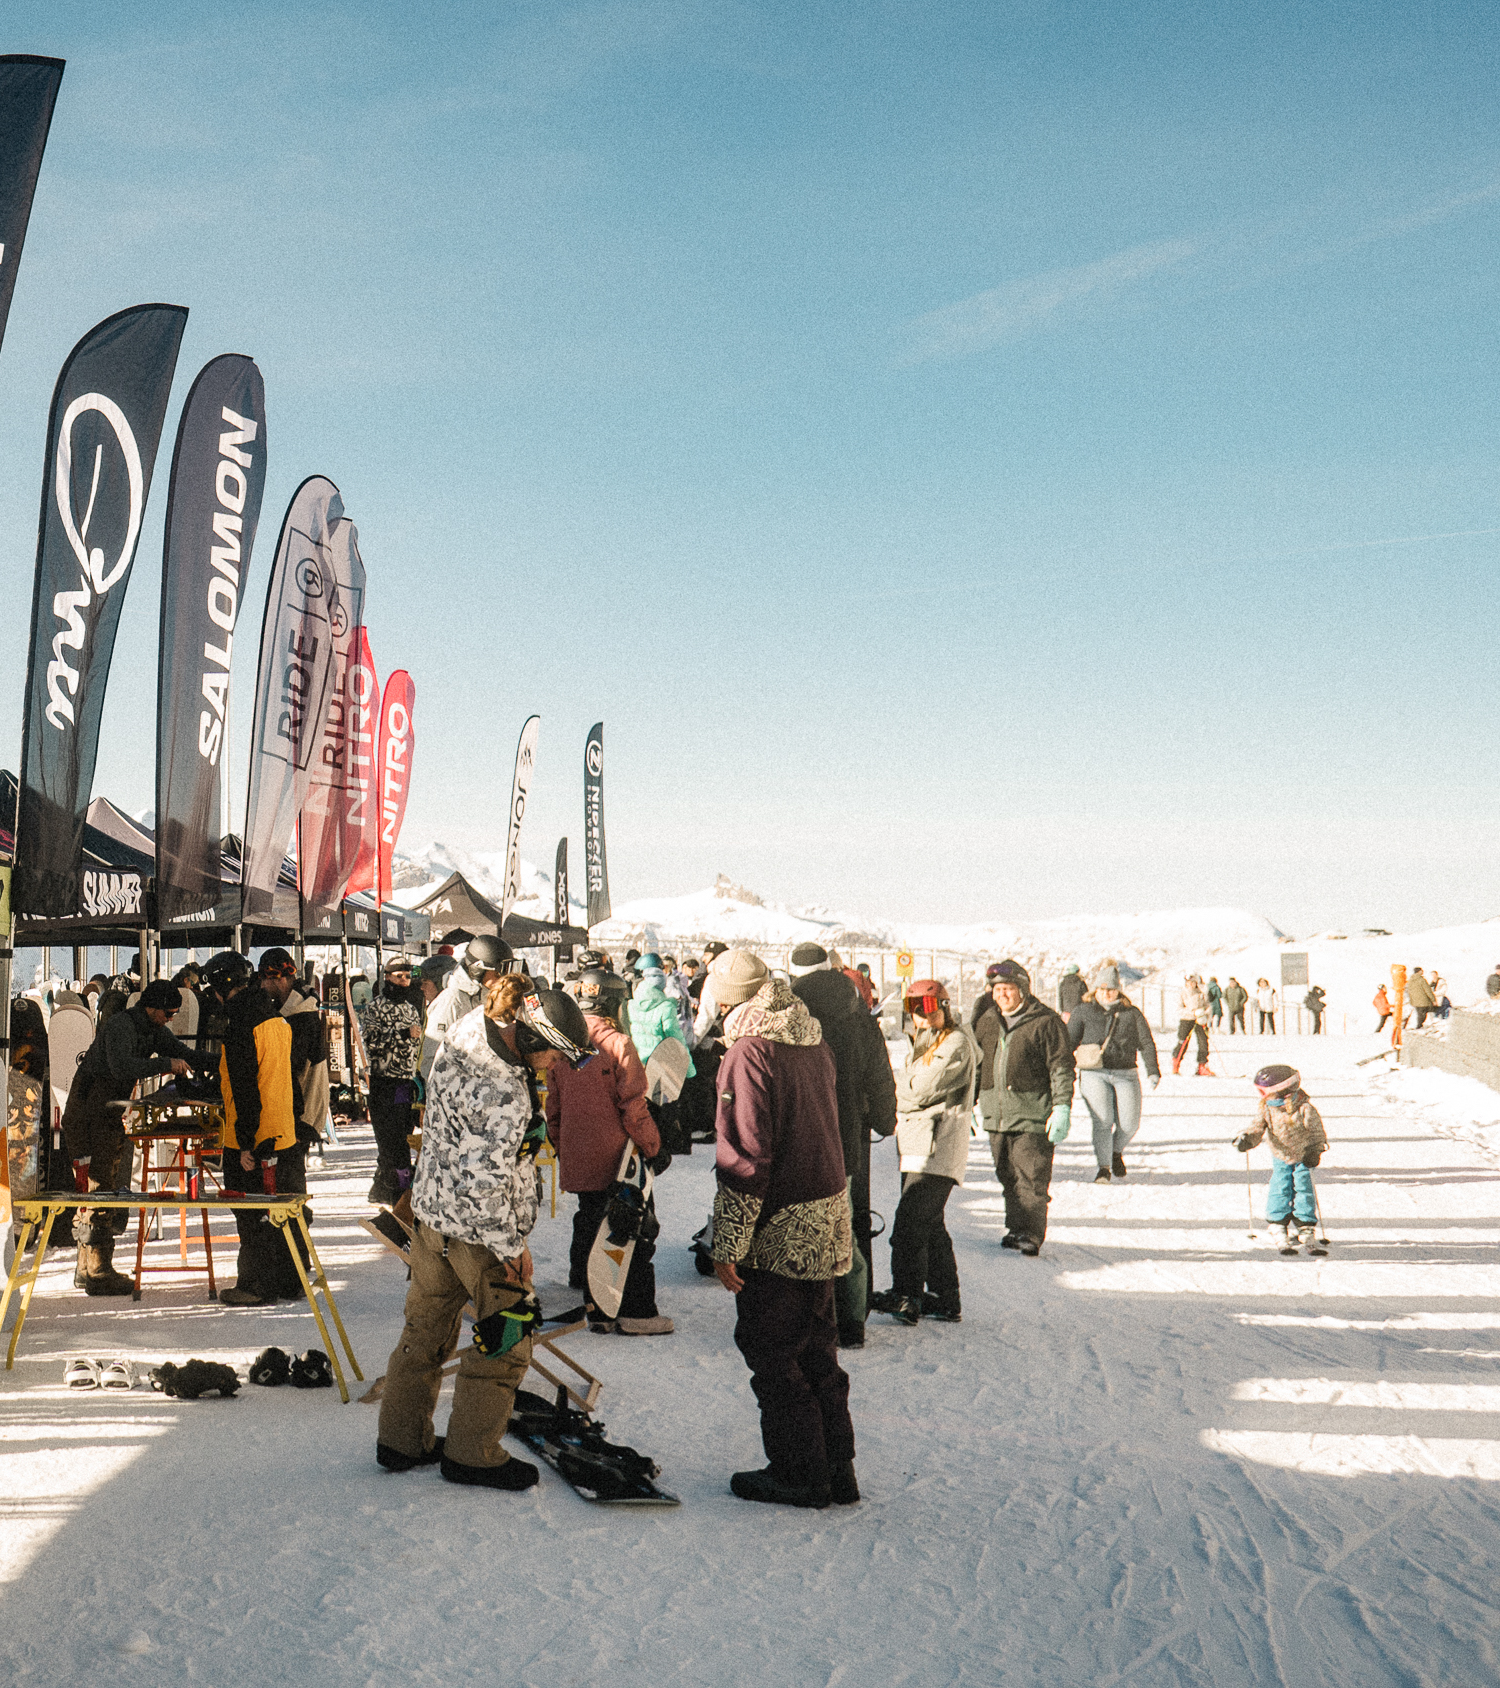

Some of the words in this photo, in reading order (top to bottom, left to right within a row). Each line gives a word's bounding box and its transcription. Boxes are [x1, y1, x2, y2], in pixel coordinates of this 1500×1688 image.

[198, 405, 259, 766] SALOMON
[276, 628, 318, 745] RIDE
[346, 663, 374, 827] NITRO
[382, 701, 410, 844] NITRO
[329, 1042, 339, 1072] ROME
